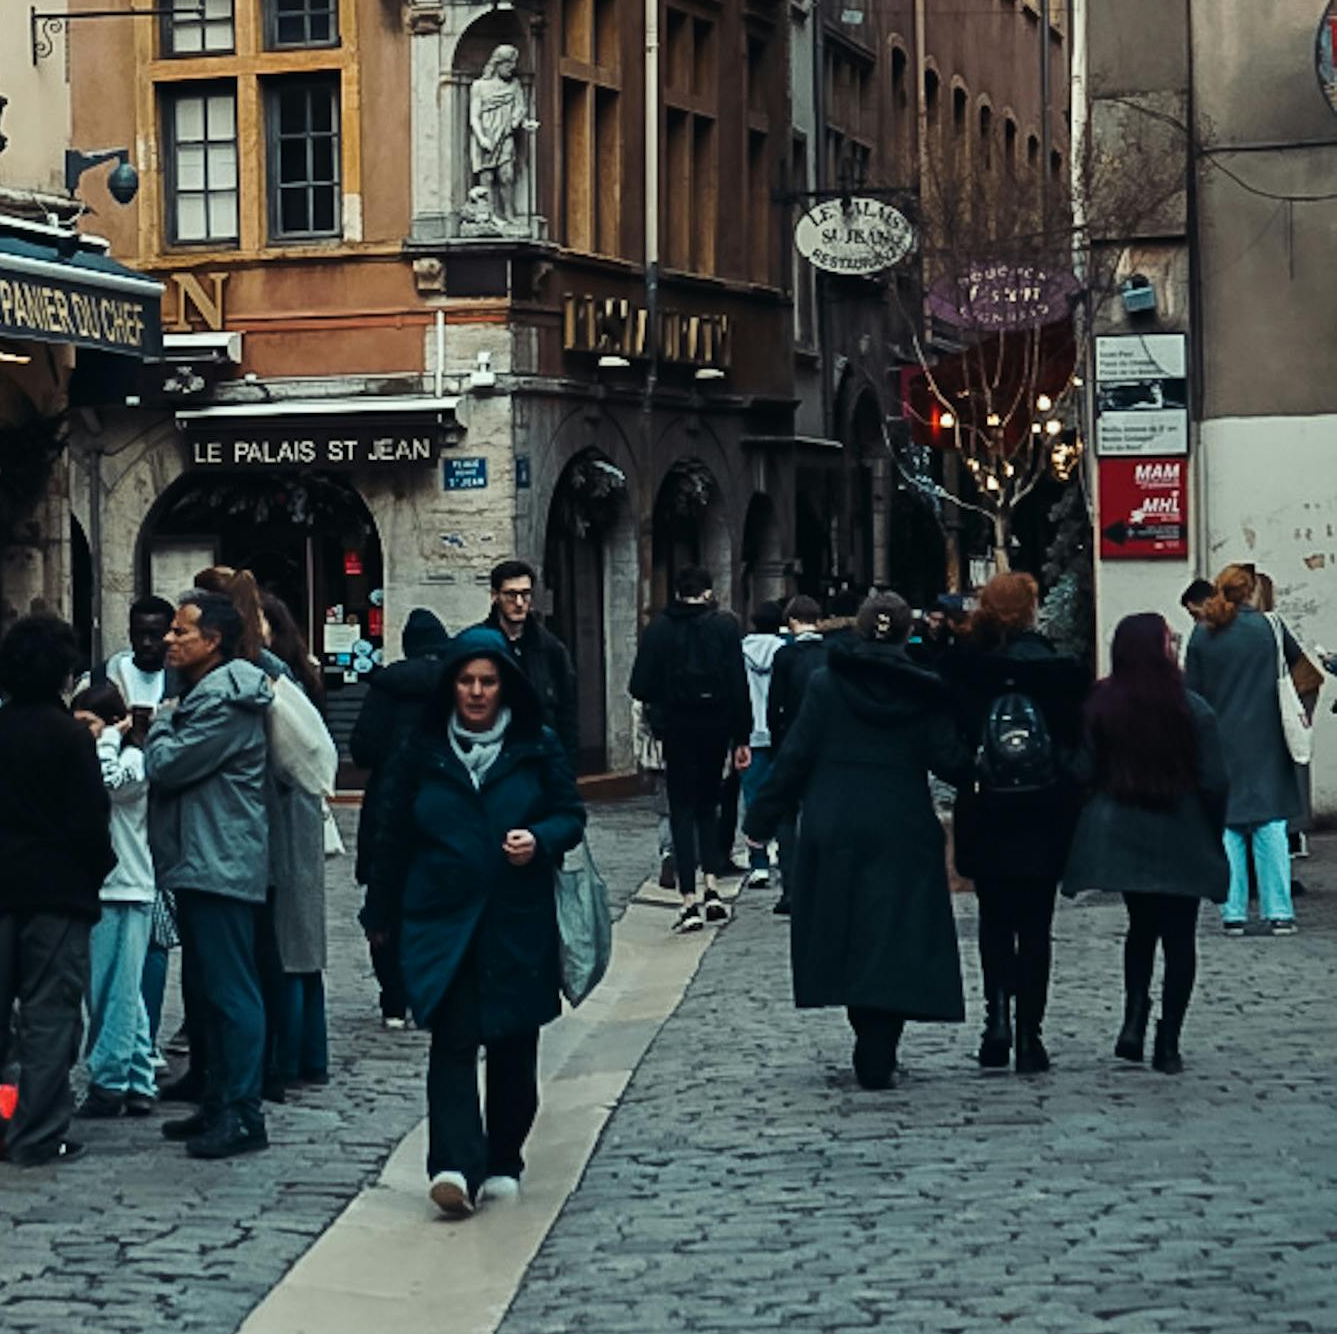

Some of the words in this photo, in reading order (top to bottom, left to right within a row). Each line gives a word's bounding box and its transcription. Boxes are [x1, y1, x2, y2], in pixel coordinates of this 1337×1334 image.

[0, 278, 69, 333] PANIER
[69, 291, 101, 339] DU
[101, 296, 144, 346] CHEF
[194, 442, 222, 463] LE
[234, 440, 316, 463] PALAIS
[328, 440, 358, 461] ST
[368, 438, 431, 461] JEAN
[1135, 464, 1180, 481] MAM
